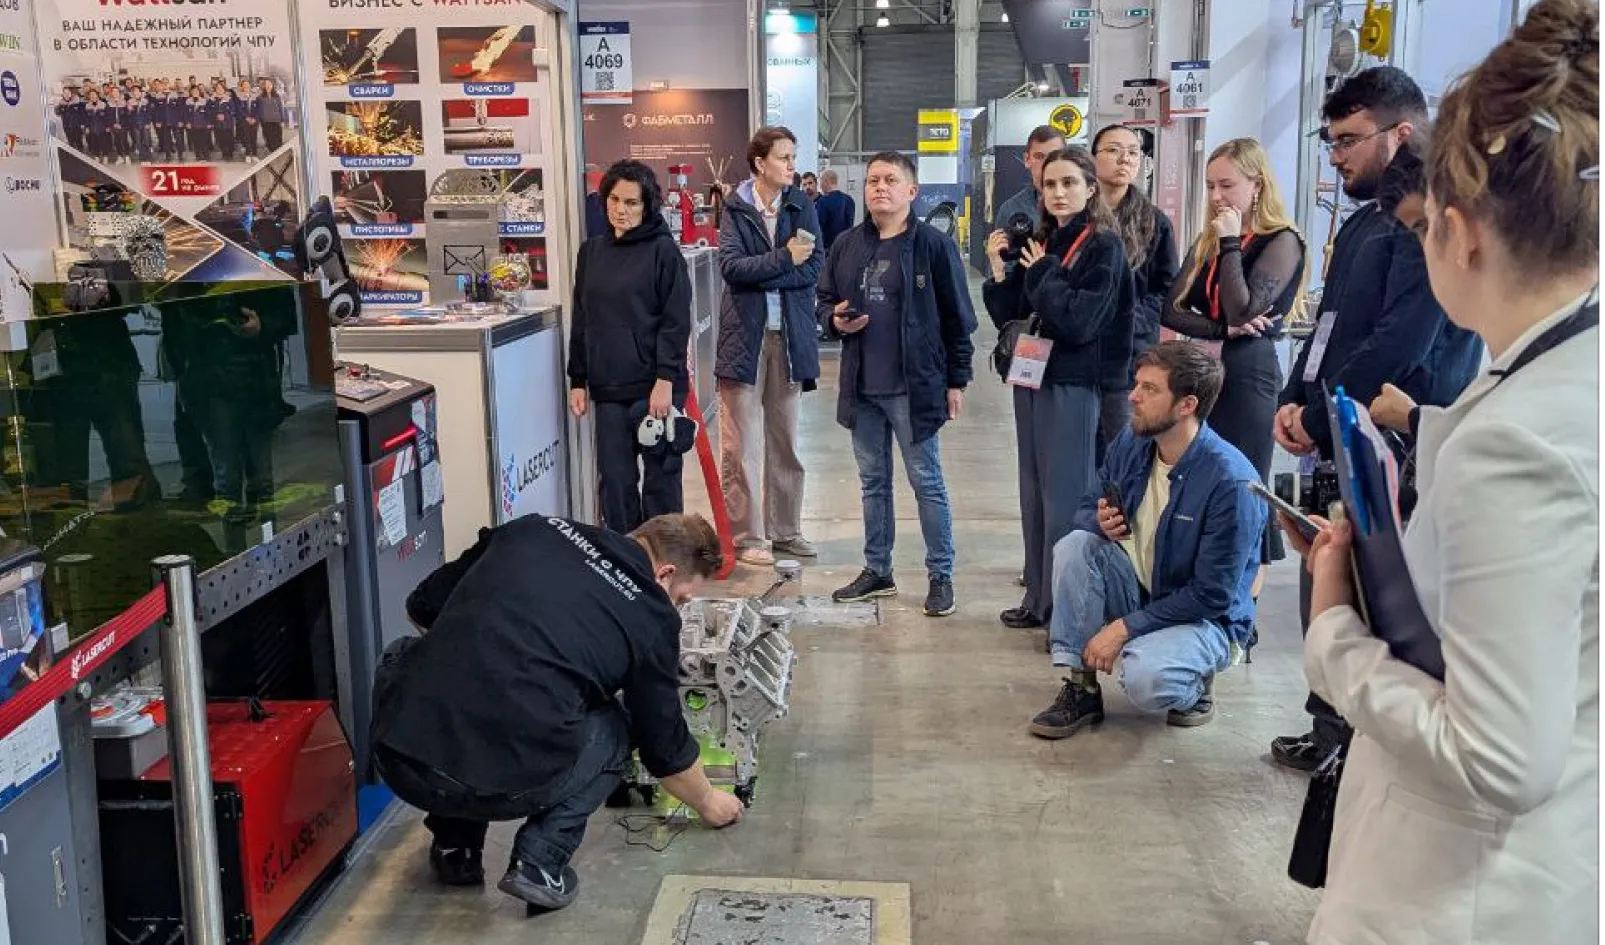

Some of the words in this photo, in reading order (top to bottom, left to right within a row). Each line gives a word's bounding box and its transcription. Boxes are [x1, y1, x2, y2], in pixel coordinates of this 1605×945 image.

[62, 20, 96, 31] ВАШ
[102, 15, 192, 32] НАДЕЖНЫЙ
[198, 17, 263, 30] ПАРТНЕР
[53, 39, 61, 50] В
[68, 38, 137, 50] ОБЛАСТИ
[142, 33, 242, 50] ТЕХНОЛОГИЙ
[247, 35, 275, 48] ЧПУ
[597, 36, 610, 52] A
[585, 53, 623, 69] 4069
[353, 86, 390, 95] СВАРКИ
[1176, 83, 1203, 93] 4061
[1127, 98, 1151, 108] 4071
[641, 113, 714, 125] ФАБМЕТАЛЛ
[345, 156, 410, 166] МЕТАЛЛОРЕЗЫ
[151, 170, 178, 191] 21
[506, 224, 541, 233] СТАНКИ
[360, 291, 418, 301] АРКИРАТОРЫ
[516, 439, 560, 493] LASERCUT
[548, 518, 602, 560] СТАНКИ
[81, 631, 116, 666] LASERCUT
